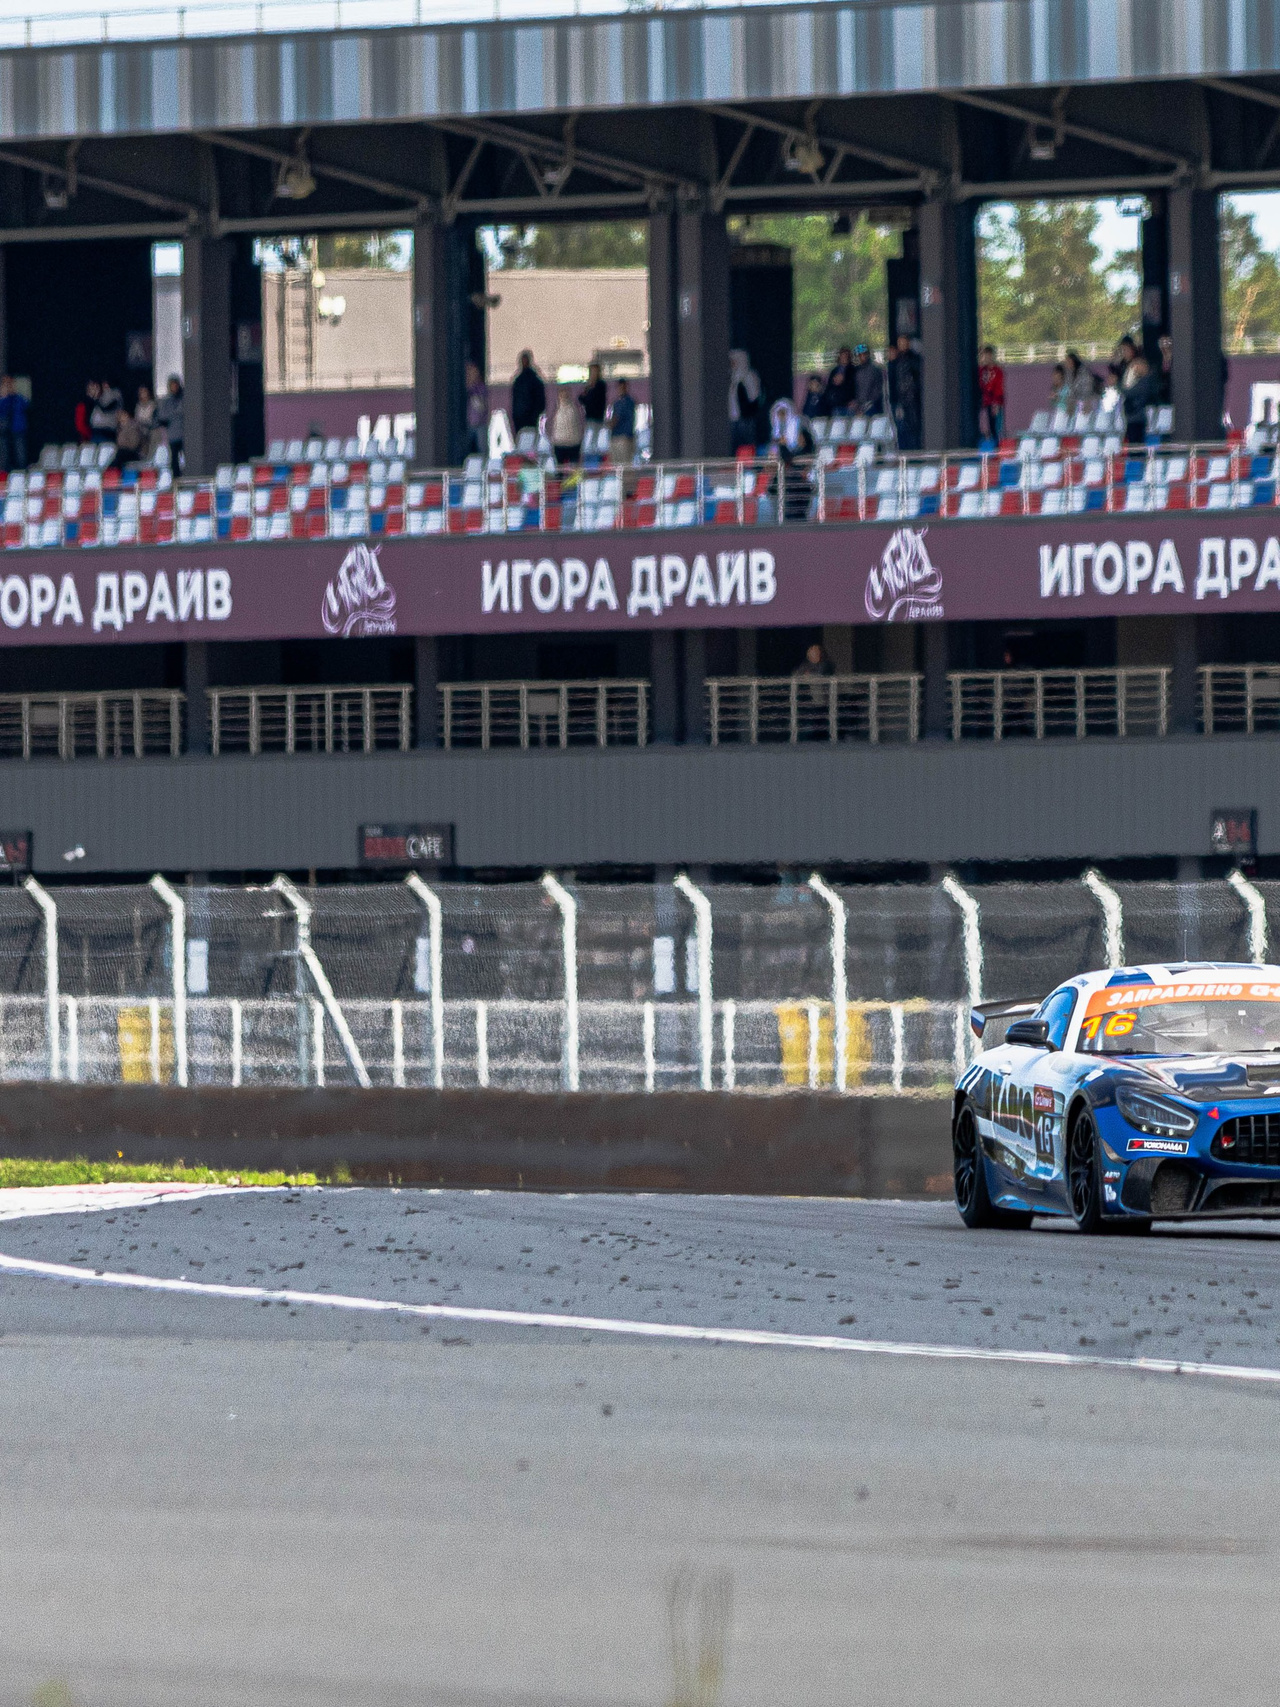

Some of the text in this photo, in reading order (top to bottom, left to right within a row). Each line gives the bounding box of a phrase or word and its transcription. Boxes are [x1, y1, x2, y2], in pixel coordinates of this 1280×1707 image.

[482, 549, 777, 617] ИГОРА ДРАЙВ
[1040, 540, 1185, 598] ИГОРА
[0, 569, 232, 632] ОРА ДРАЙВ
[1107, 984, 1243, 1007] ЗАПРАВЛЕНО
[1081, 1012, 1138, 1039] 16
[1037, 1115, 1052, 1154] 16
[1143, 1141, 1183, 1152] YOKOHAMA
